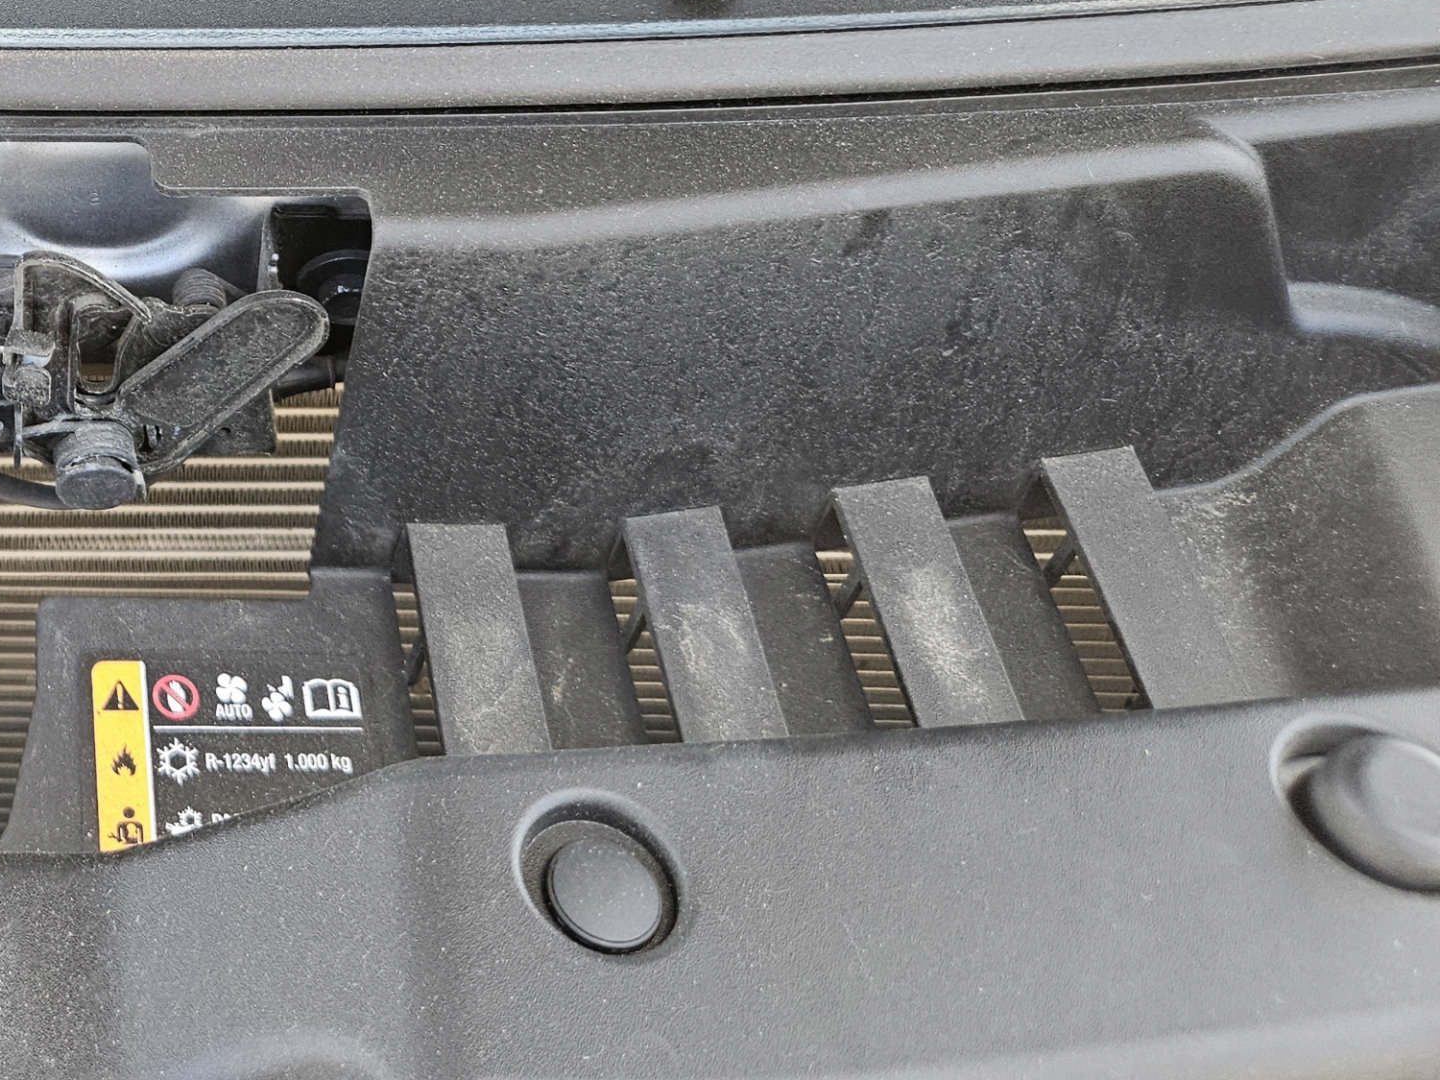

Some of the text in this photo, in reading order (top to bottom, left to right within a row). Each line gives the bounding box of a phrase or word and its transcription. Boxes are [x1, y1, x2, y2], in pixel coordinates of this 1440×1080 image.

[215, 703, 254, 721] AUTO
[205, 752, 354, 776] R-1234yf 1.000 kg
